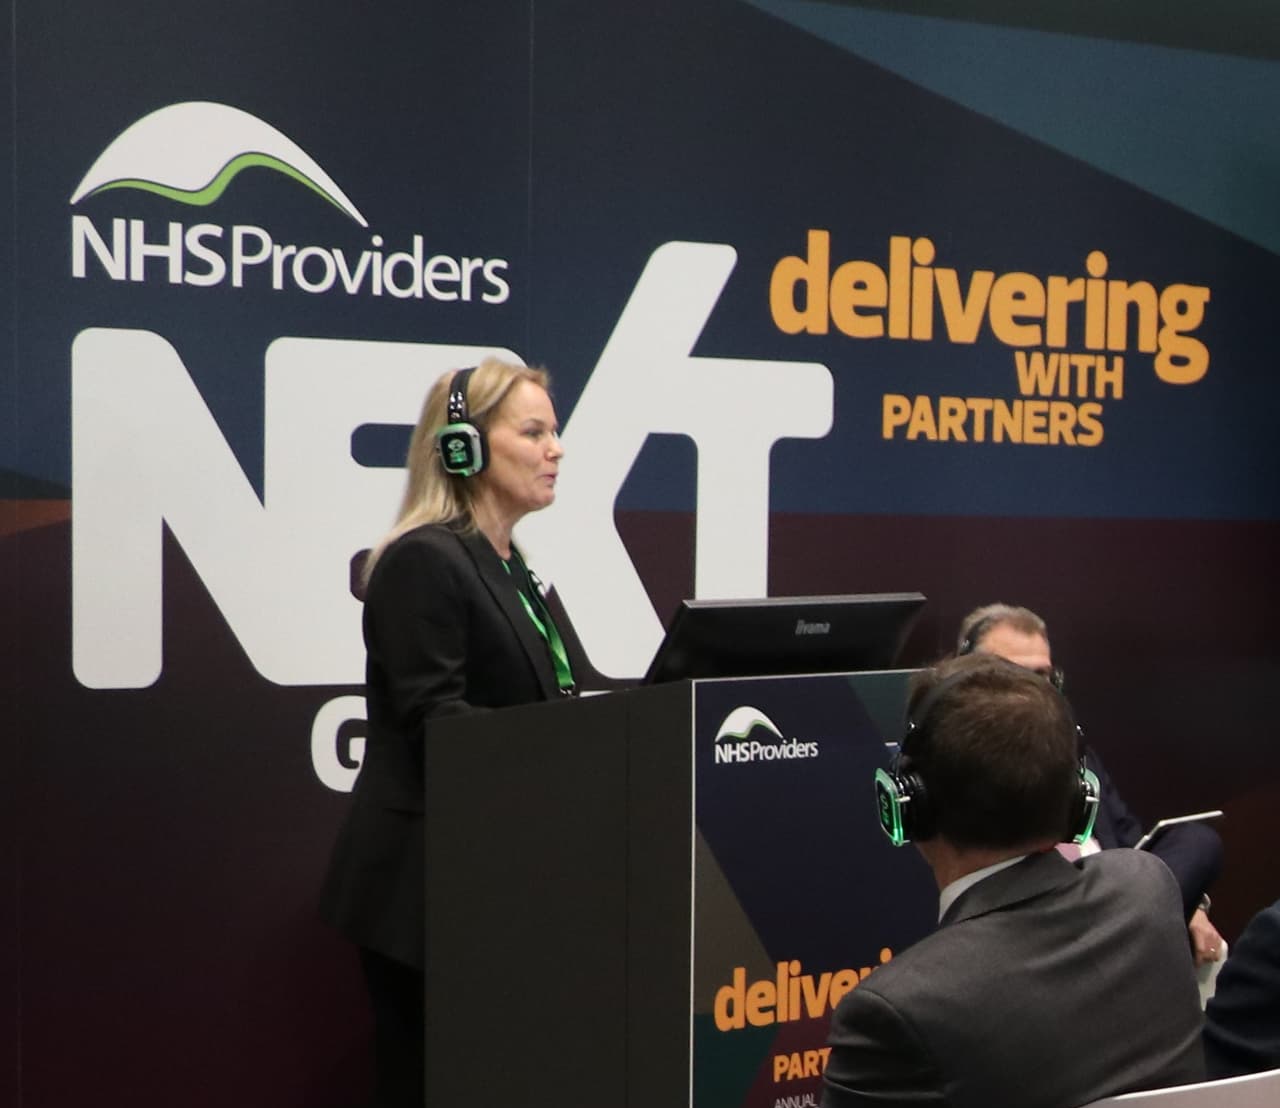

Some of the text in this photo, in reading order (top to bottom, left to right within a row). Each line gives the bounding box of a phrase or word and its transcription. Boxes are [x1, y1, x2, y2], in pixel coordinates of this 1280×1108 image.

[769, 229, 1210, 385] delivering
[1015, 351, 1124, 399] WITH
[882, 394, 1103, 447] PARTNERS
